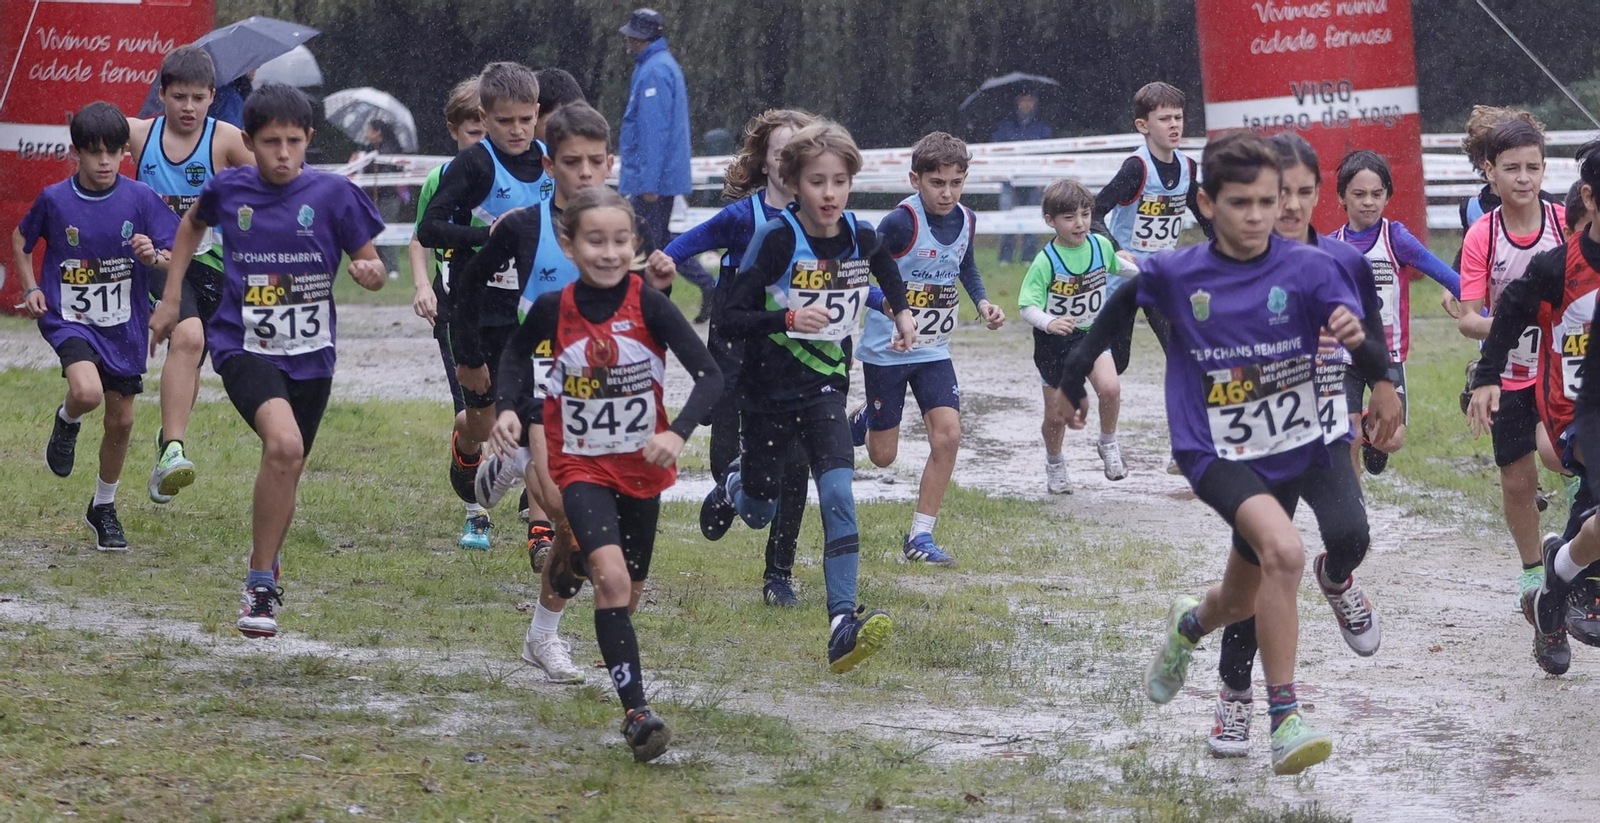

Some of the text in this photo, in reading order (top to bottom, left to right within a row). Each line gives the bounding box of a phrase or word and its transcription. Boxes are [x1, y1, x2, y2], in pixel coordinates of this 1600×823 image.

[1251, 0, 1331, 24] Vivimos
[36, 27, 112, 52] Vivimos
[1250, 24, 1394, 54] cidade fermosa
[29, 57, 92, 83] cidade
[1290, 79, 1360, 106] VIGO,
[1242, 104, 1403, 133] terreo de xogo
[18, 137, 79, 162] terre
[1135, 216, 1182, 241] 330
[244, 252, 277, 263] CHANS
[278, 252, 323, 263] BEMBRIVE
[291, 281, 331, 293] BELARMINO
[294, 273, 331, 284] MEMORIAL
[71, 283, 121, 313] 311
[302, 290, 330, 301] ALONSO
[1049, 290, 1102, 317] 350
[252, 305, 320, 340] 313
[1212, 345, 1253, 360] CHANS
[1253, 336, 1302, 356] BEMBRIVE
[606, 370, 652, 386] BELARMINO
[1259, 361, 1312, 385] BELARMINO
[1275, 371, 1311, 391] ALONSO
[621, 379, 653, 393] ALONSO
[566, 397, 649, 436] 342
[1219, 390, 1306, 445] 312
